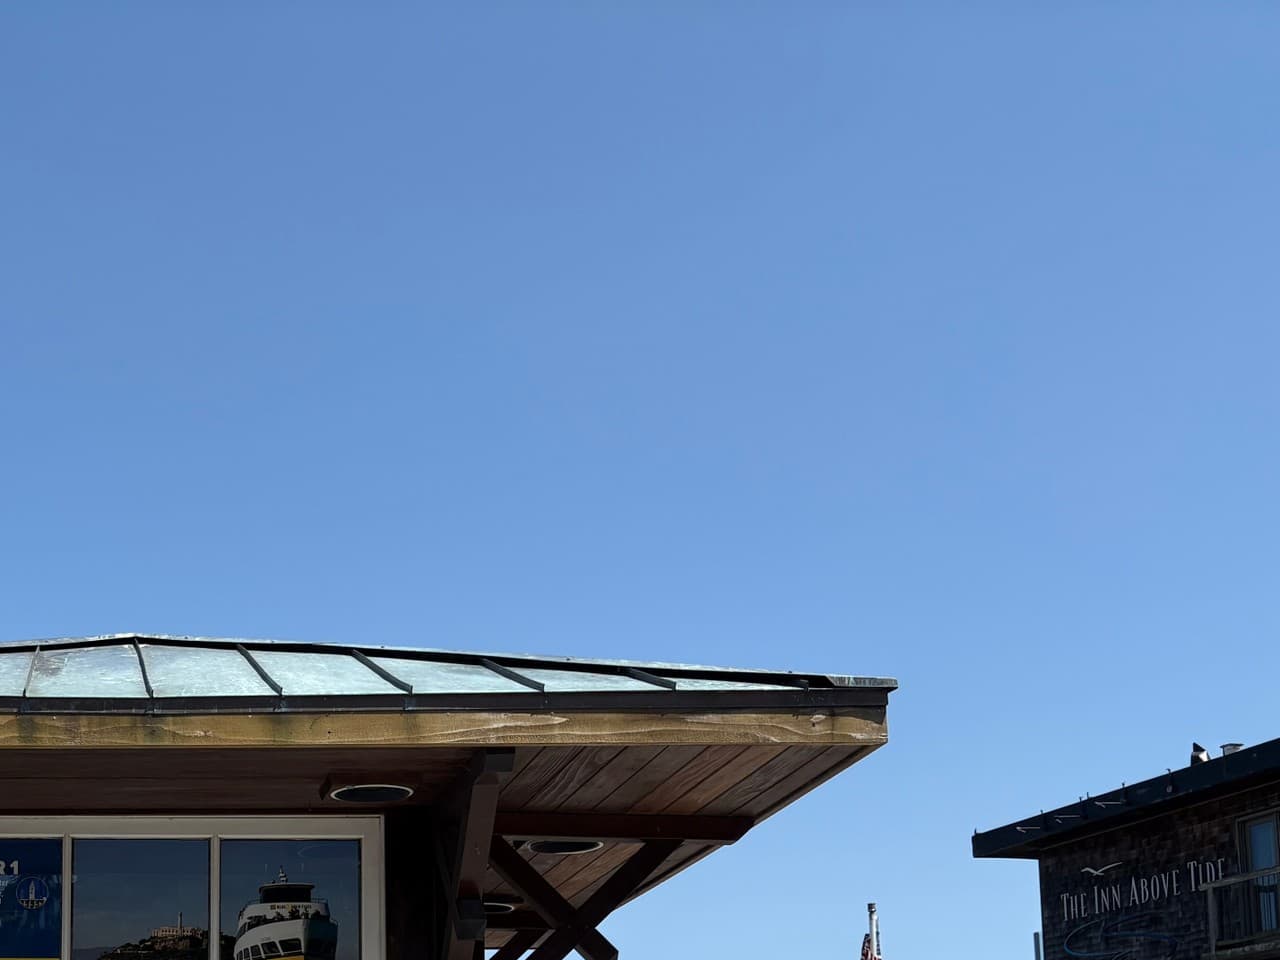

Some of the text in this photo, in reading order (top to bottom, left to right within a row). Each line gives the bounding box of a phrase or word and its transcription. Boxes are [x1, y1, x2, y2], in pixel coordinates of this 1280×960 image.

[9, 860, 19, 875] 1
[1060, 892, 1088, 921] THE
[1093, 884, 1121, 914] INN
[1129, 870, 1181, 906] ABOVE
